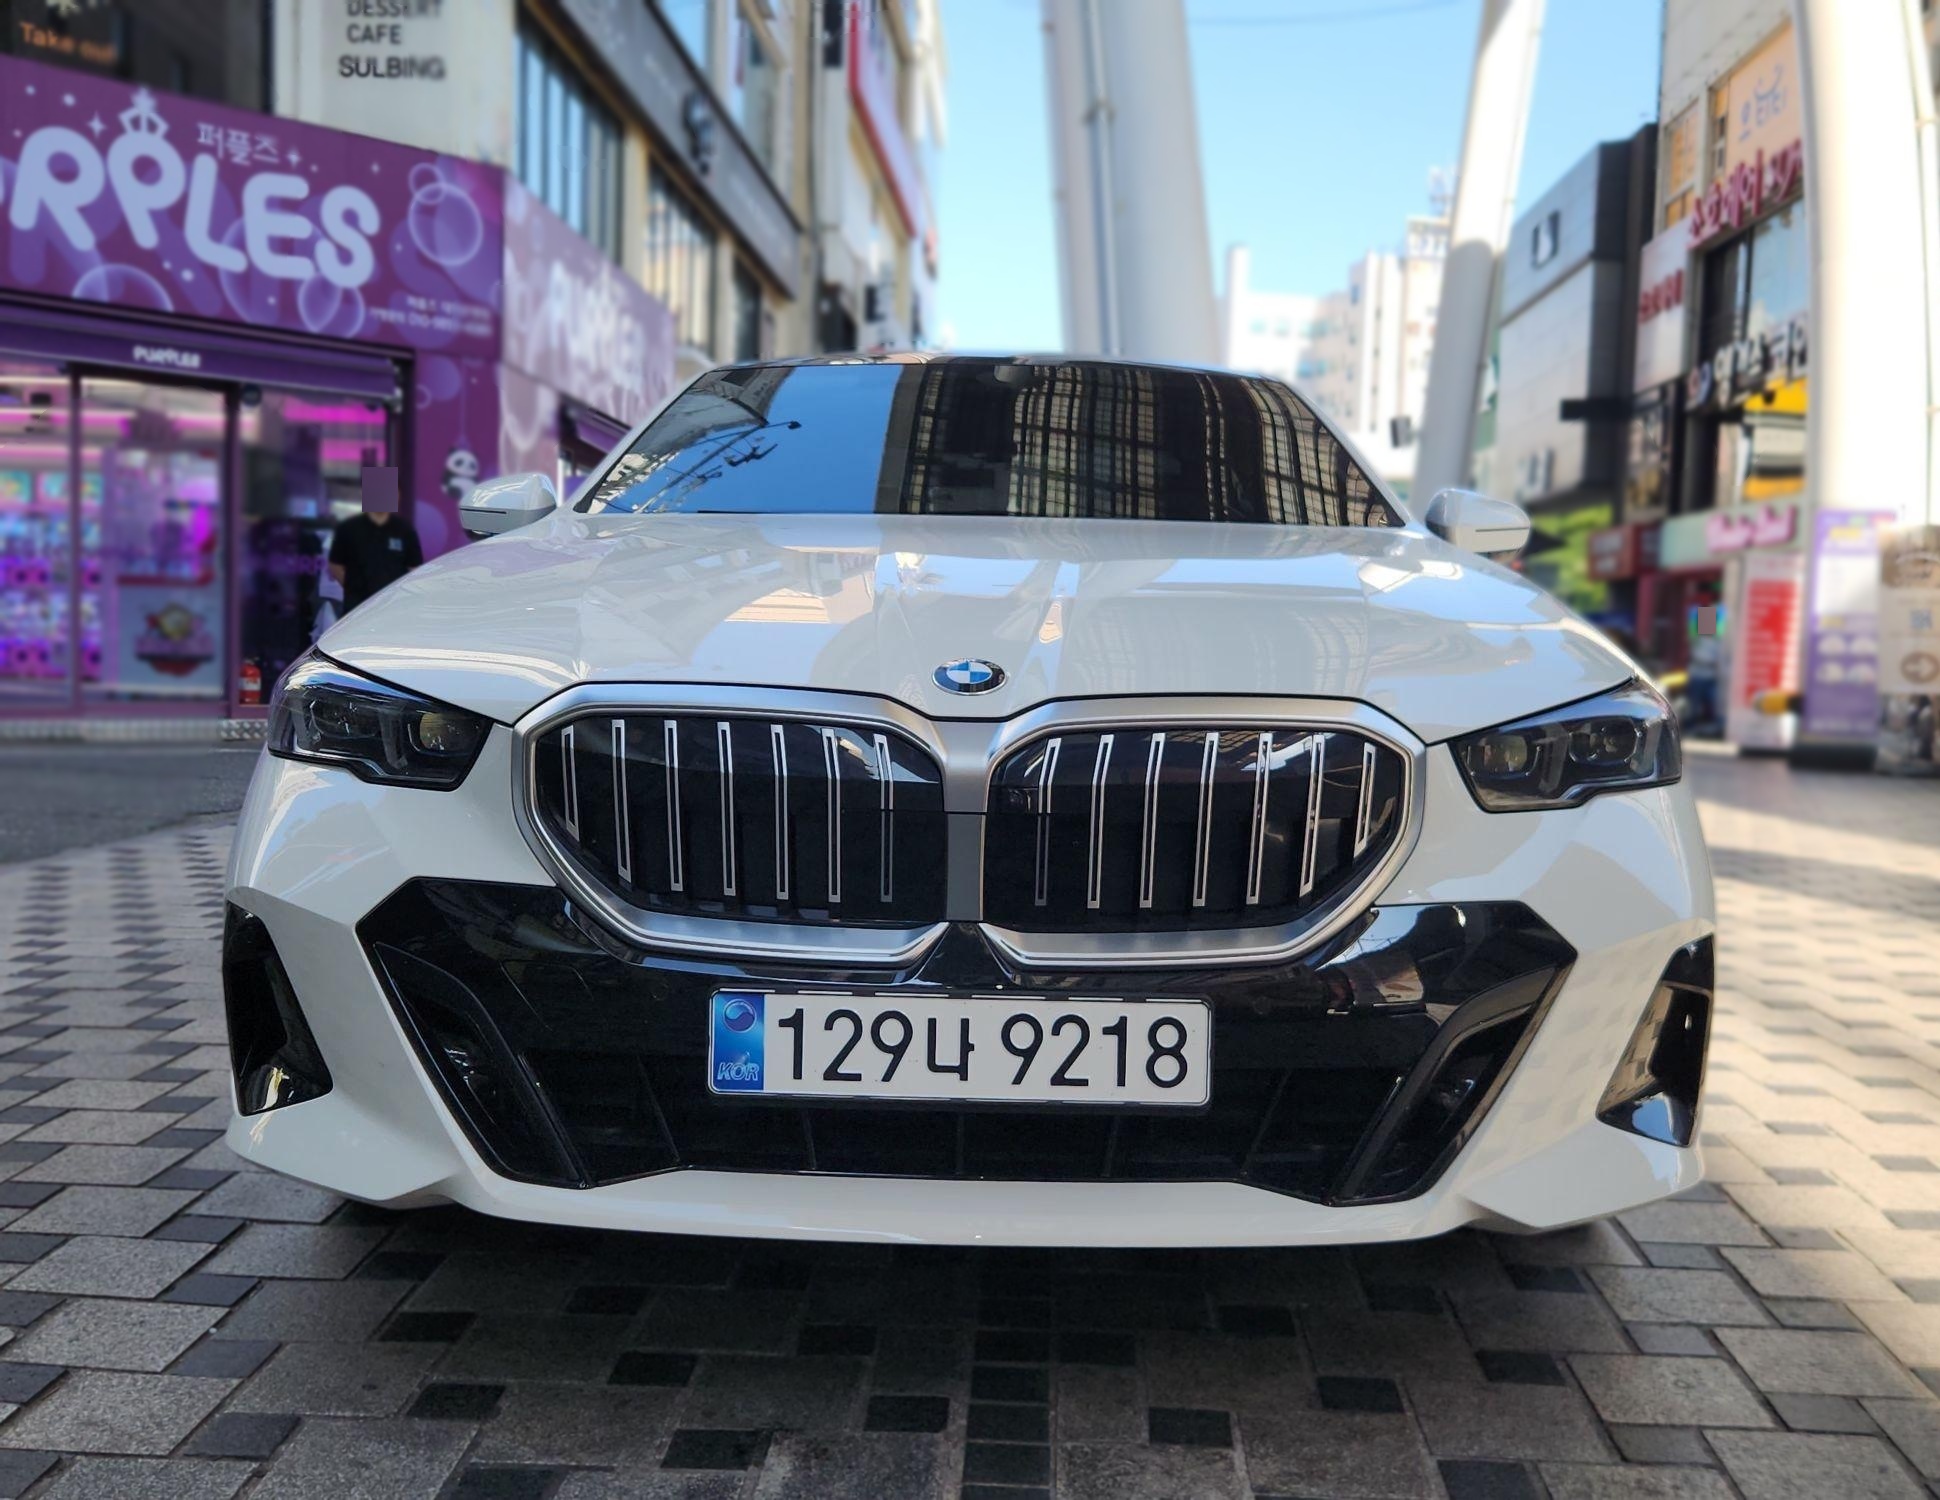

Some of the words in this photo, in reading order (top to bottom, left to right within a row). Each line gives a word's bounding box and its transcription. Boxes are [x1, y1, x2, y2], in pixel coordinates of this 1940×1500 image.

[346, 23, 402, 45] CAFE
[339, 55, 446, 80] SULBING
[197, 122, 280, 167] 퍼플즈
[0, 126, 380, 289] RPLES
[778, 1008, 975, 1083] 129나
[1000, 1012, 1189, 1089] 9218
[717, 1061, 760, 1081] KOR
